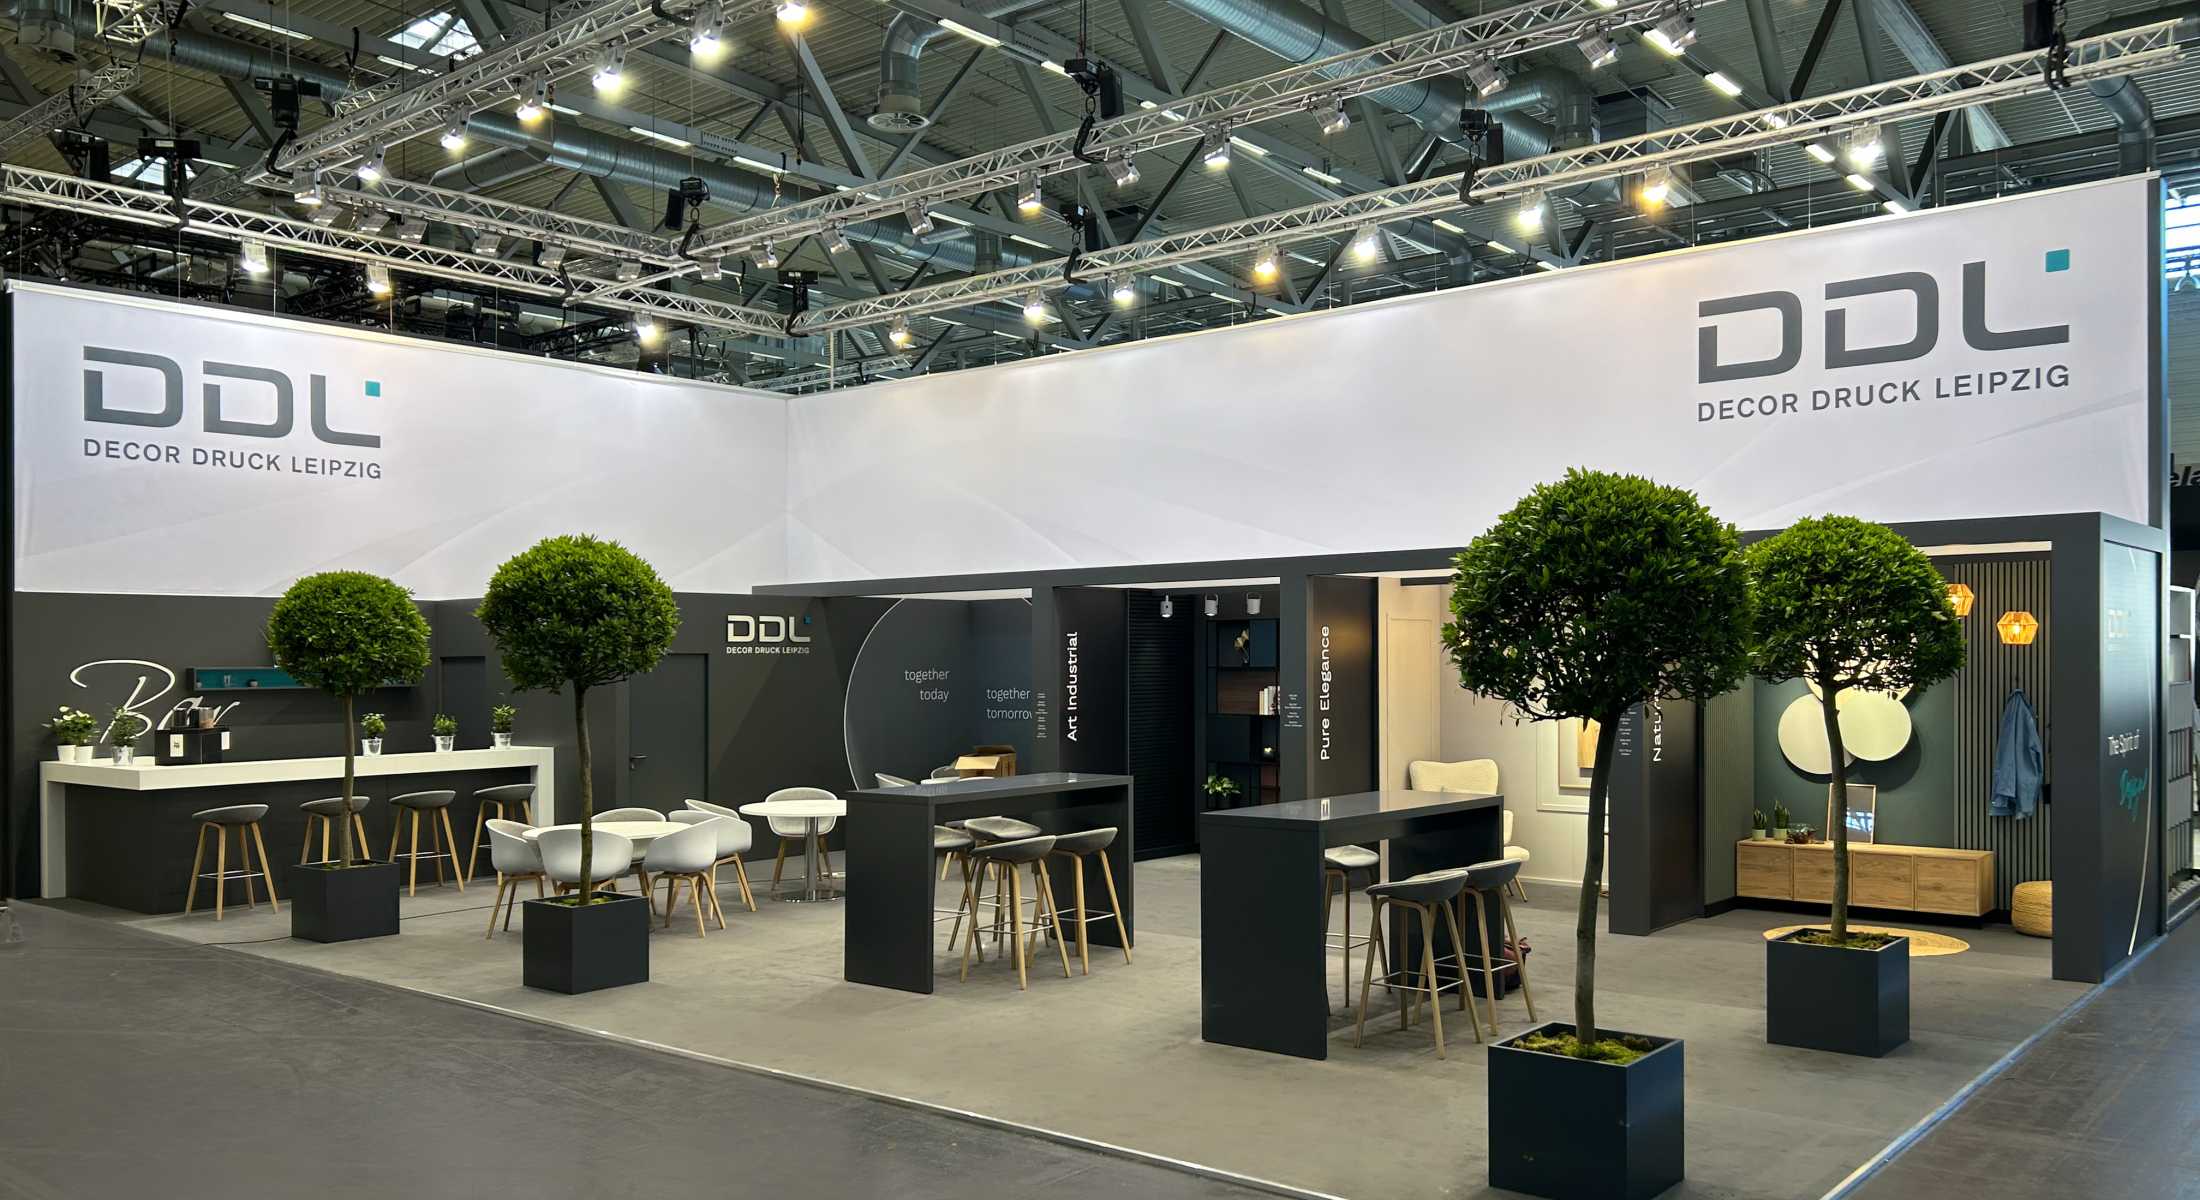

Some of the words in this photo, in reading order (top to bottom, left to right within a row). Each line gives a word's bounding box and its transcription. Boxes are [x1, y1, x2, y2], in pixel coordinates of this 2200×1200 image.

[1698, 261, 2070, 384] DDL
[83, 345, 381, 449] DDL
[1698, 392, 1798, 422] DECOR
[1811, 379, 1921, 411] DRUCK
[1935, 364, 2070, 399] LEIPZIG
[83, 438, 180, 464] DECOR
[192, 447, 281, 472] DRUCK
[291, 456, 381, 479] LEIPZIG
[727, 614, 811, 643] DDL
[726, 646, 753, 654] DECOR
[755, 646, 780, 654] DRUCK
[782, 646, 810, 654] LEIPZIG
[1319, 626, 1332, 711] Elegance
[904, 668, 951, 684] together
[1066, 631, 1078, 711] Industrial
[920, 688, 949, 703] today
[986, 687, 1031, 702] together
[1067, 716, 1077, 742] Art
[1320, 718, 1330, 760] Pure
